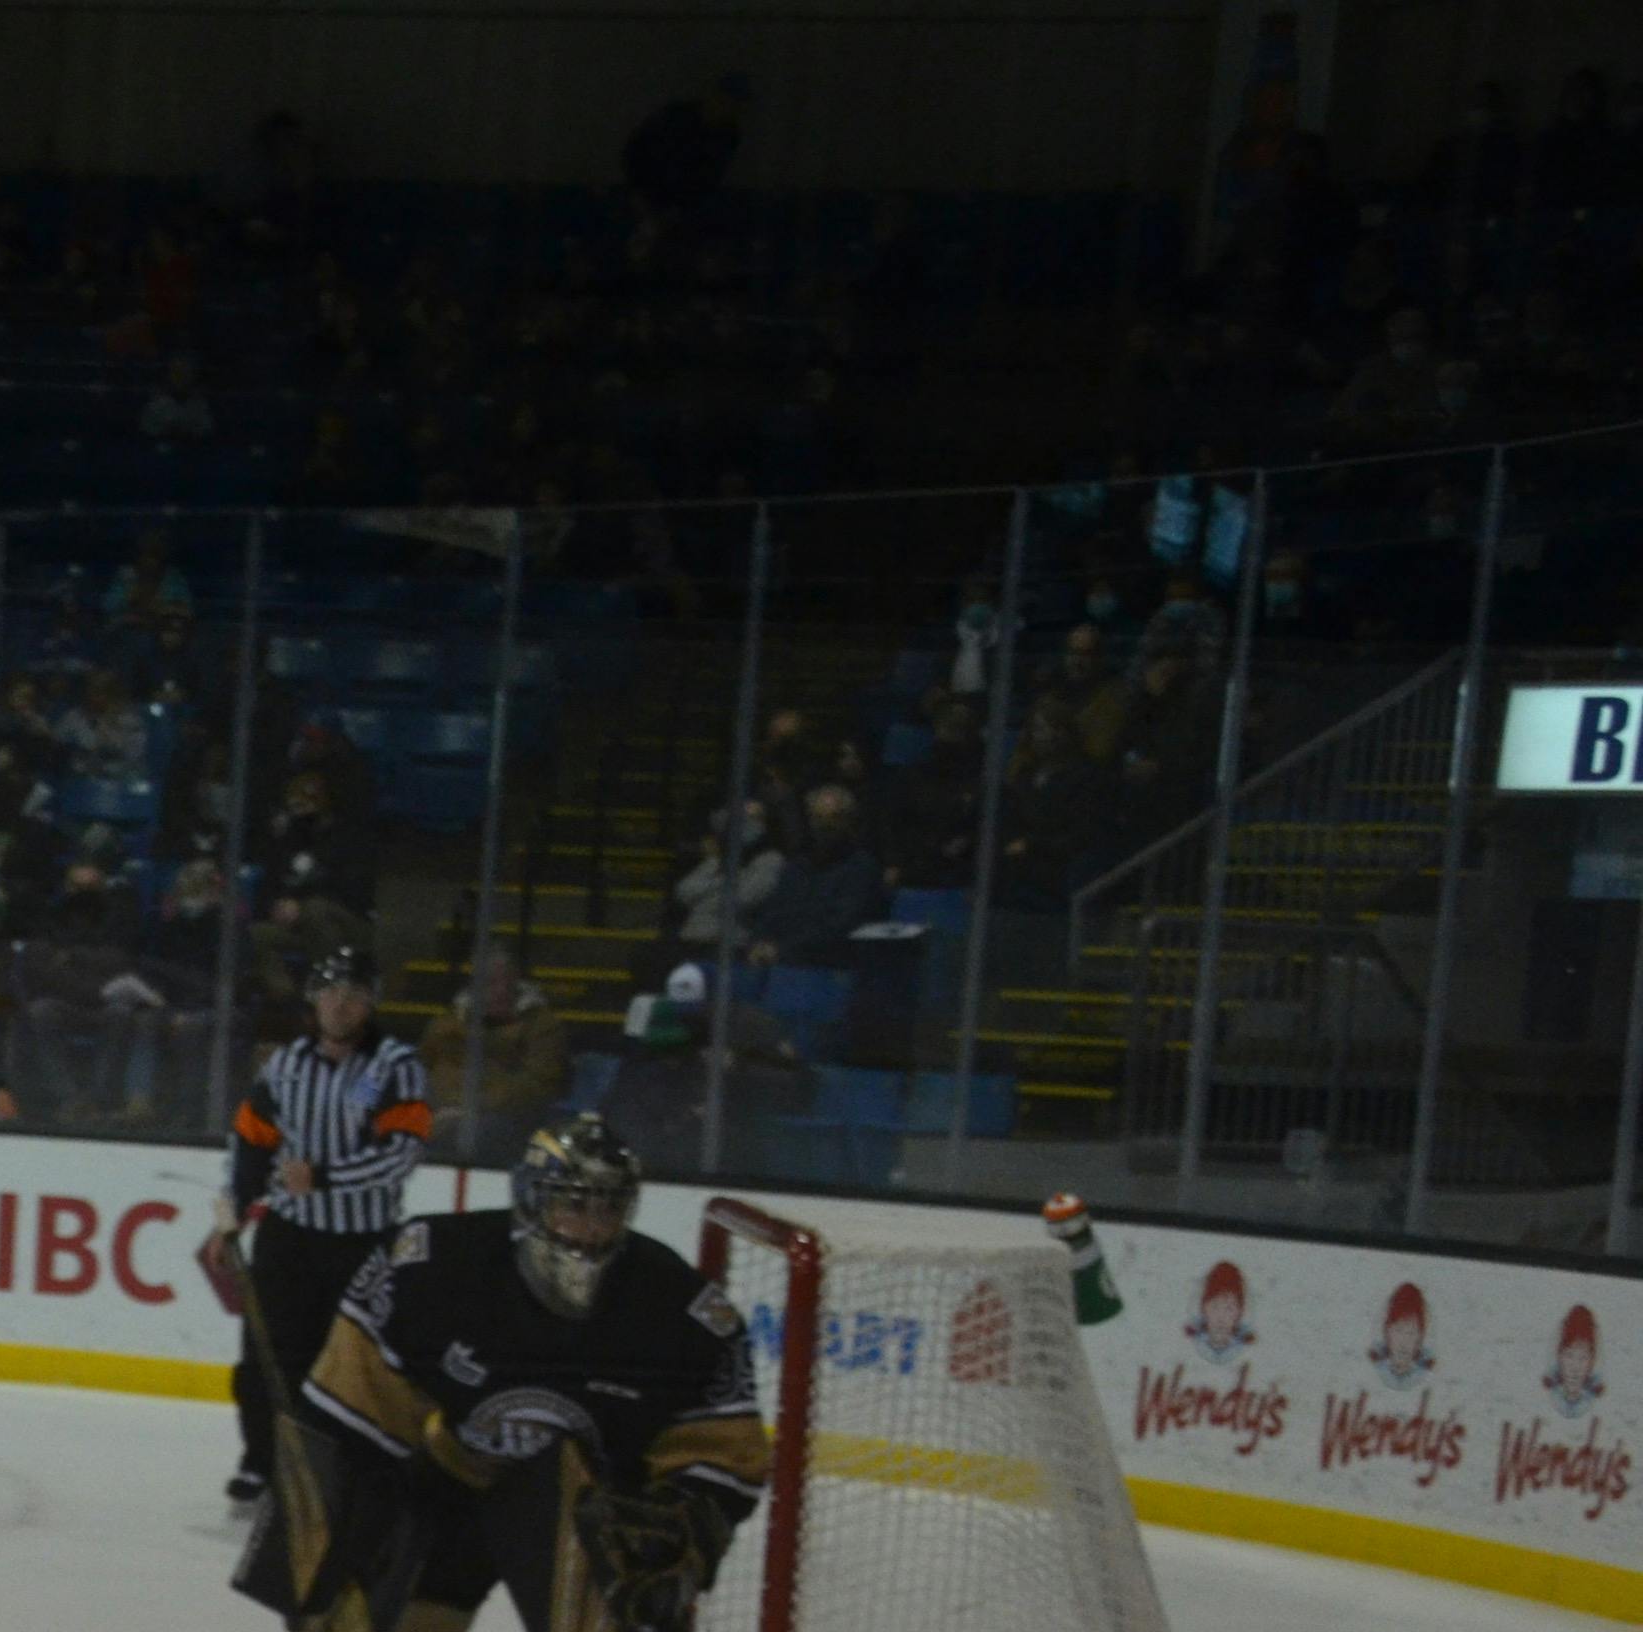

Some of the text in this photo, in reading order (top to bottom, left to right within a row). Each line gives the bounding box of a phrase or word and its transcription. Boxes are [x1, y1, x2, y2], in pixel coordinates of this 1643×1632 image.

[1135, 1362, 1287, 1456] Wendy's
[1321, 1388, 1466, 1488] Wendy's
[1495, 1416, 1632, 1520] Wendy's
